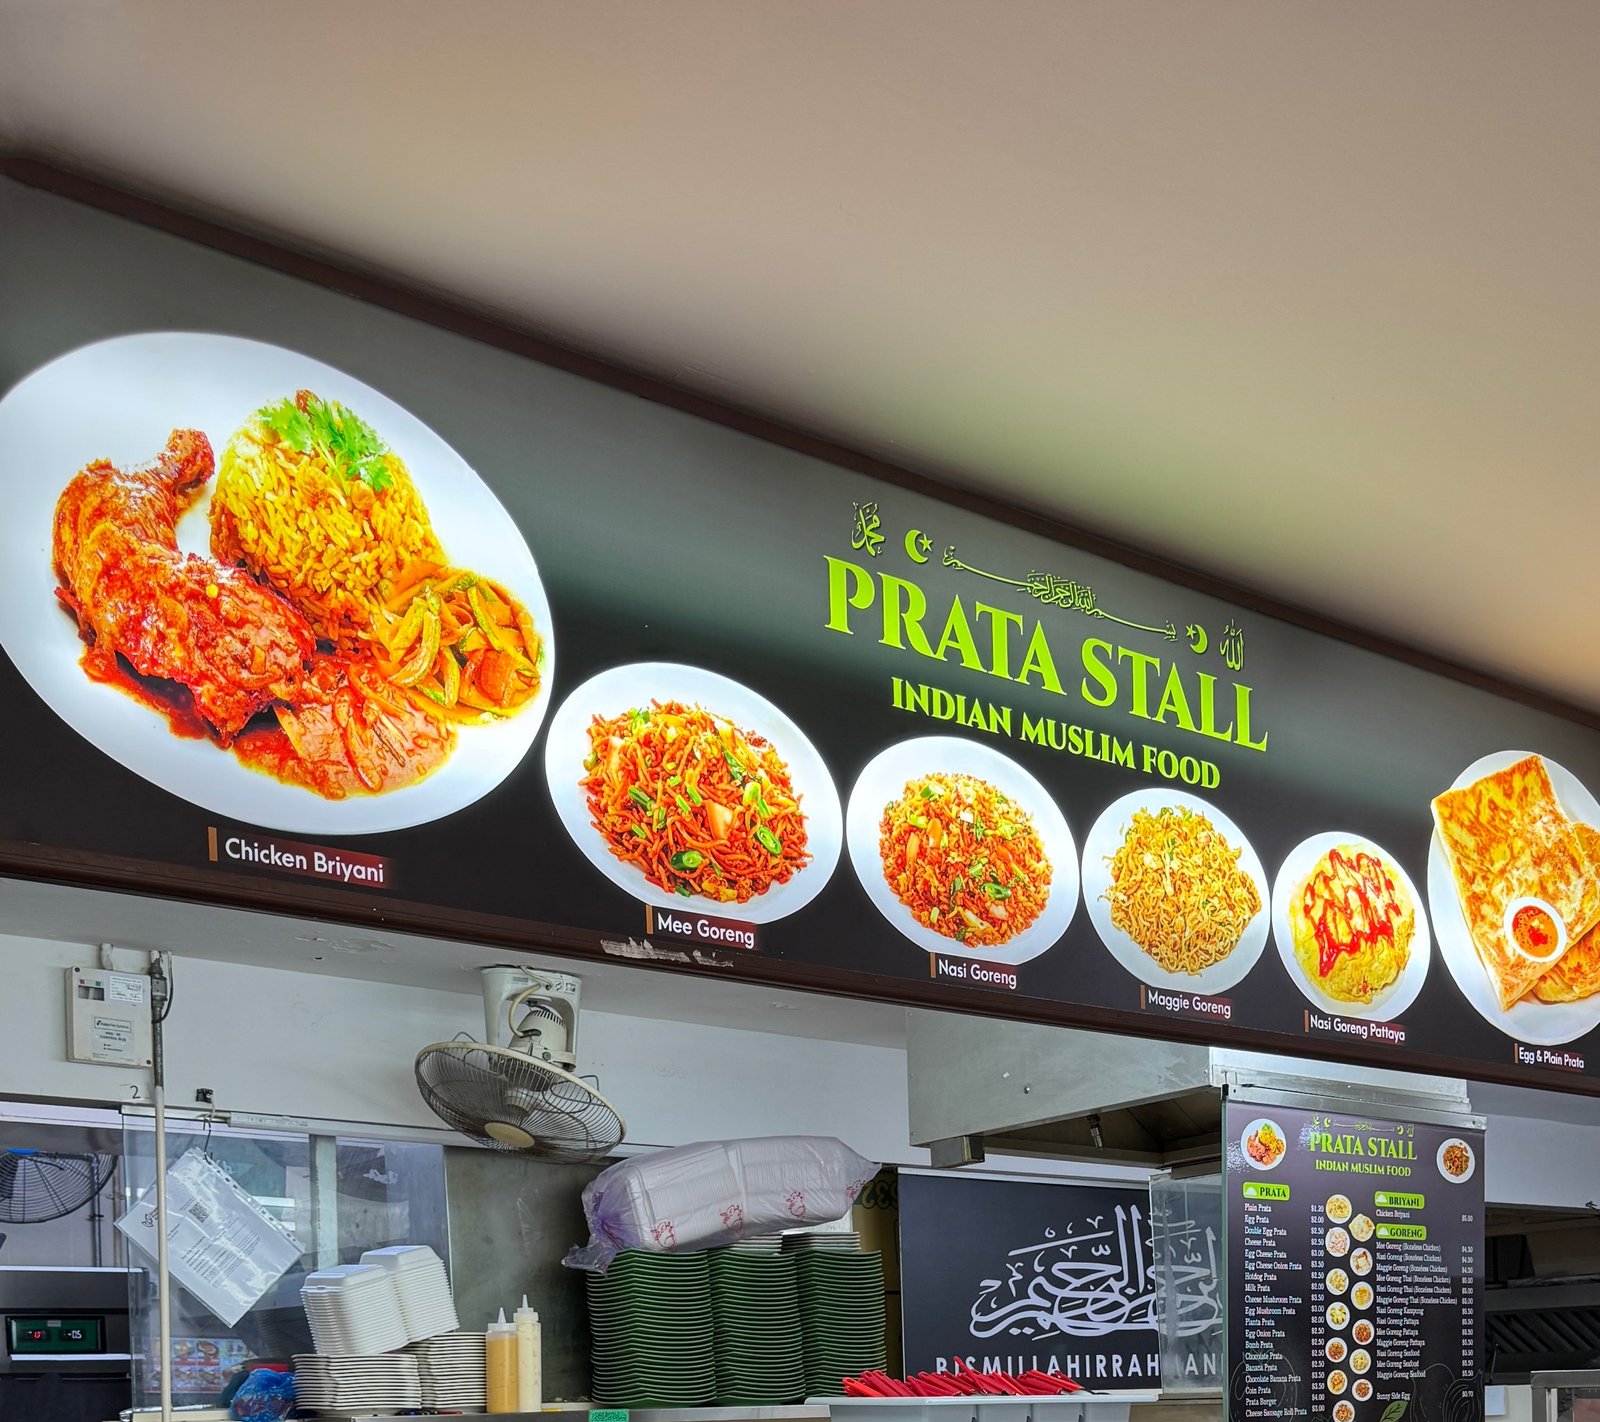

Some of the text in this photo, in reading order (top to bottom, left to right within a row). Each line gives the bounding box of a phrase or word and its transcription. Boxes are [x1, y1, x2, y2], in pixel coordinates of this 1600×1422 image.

[823, 554, 1269, 752] PRATA STALL
[890, 677, 1221, 790] INDIAN MUSLIM FOOD
[224, 838, 384, 883] Chicken Briyani
[657, 912, 755, 949] Mee Goreng
[938, 959, 1017, 990] Nasi Goreng
[1148, 989, 1231, 1019] Maggie Goreng
[1310, 1014, 1405, 1043] Nasi Goreng Pattaya
[1519, 1047, 1585, 1070] Egg & Plain Prata
[130, 1085, 141, 1099] 2
[1309, 1131, 1417, 1160] PRATA STALL
[1315, 1159, 1411, 1177] INDIAN MUSLIM FOOD
[1260, 1187, 1286, 1197] PRATA
[1389, 1196, 1419, 1207] BRIYANI
[1258, 1204, 1271, 1212] Prata
[1245, 1214, 1269, 1225] Egg Prata
[1263, 1227, 1273, 1237] Egg
[1274, 1227, 1287, 1236] Prata
[1390, 1228, 1422, 1238] GORENG
[1263, 1238, 1276, 1247] Prata
[1245, 1249, 1255, 1259] Egg
[1274, 1250, 1287, 1259] Prata
[1245, 1261, 1255, 1271] Egg
[1289, 1262, 1302, 1270] Prata
[1264, 1272, 1277, 1281] Prata
[1257, 1284, 1270, 1292] Prata
[1289, 1295, 1302, 1304] Prata
[1245, 1306, 1255, 1317] Egg
[1283, 1307, 1295, 1315] Prata
[1262, 1318, 1274, 1326] Prata
[1245, 1329, 1255, 1339] Egg
[1272, 1329, 1285, 1337] Prata
[1260, 1341, 1273, 1349] Prata
[1270, 1352, 1282, 1360] Prata
[1264, 1363, 1277, 1372] Prata
[1289, 1374, 1301, 1383] Prata
[1258, 1386, 1271, 1395] Prata
[1246, 1398, 1259, 1406] Prata
[1295, 1407, 1307, 1415] Prata
